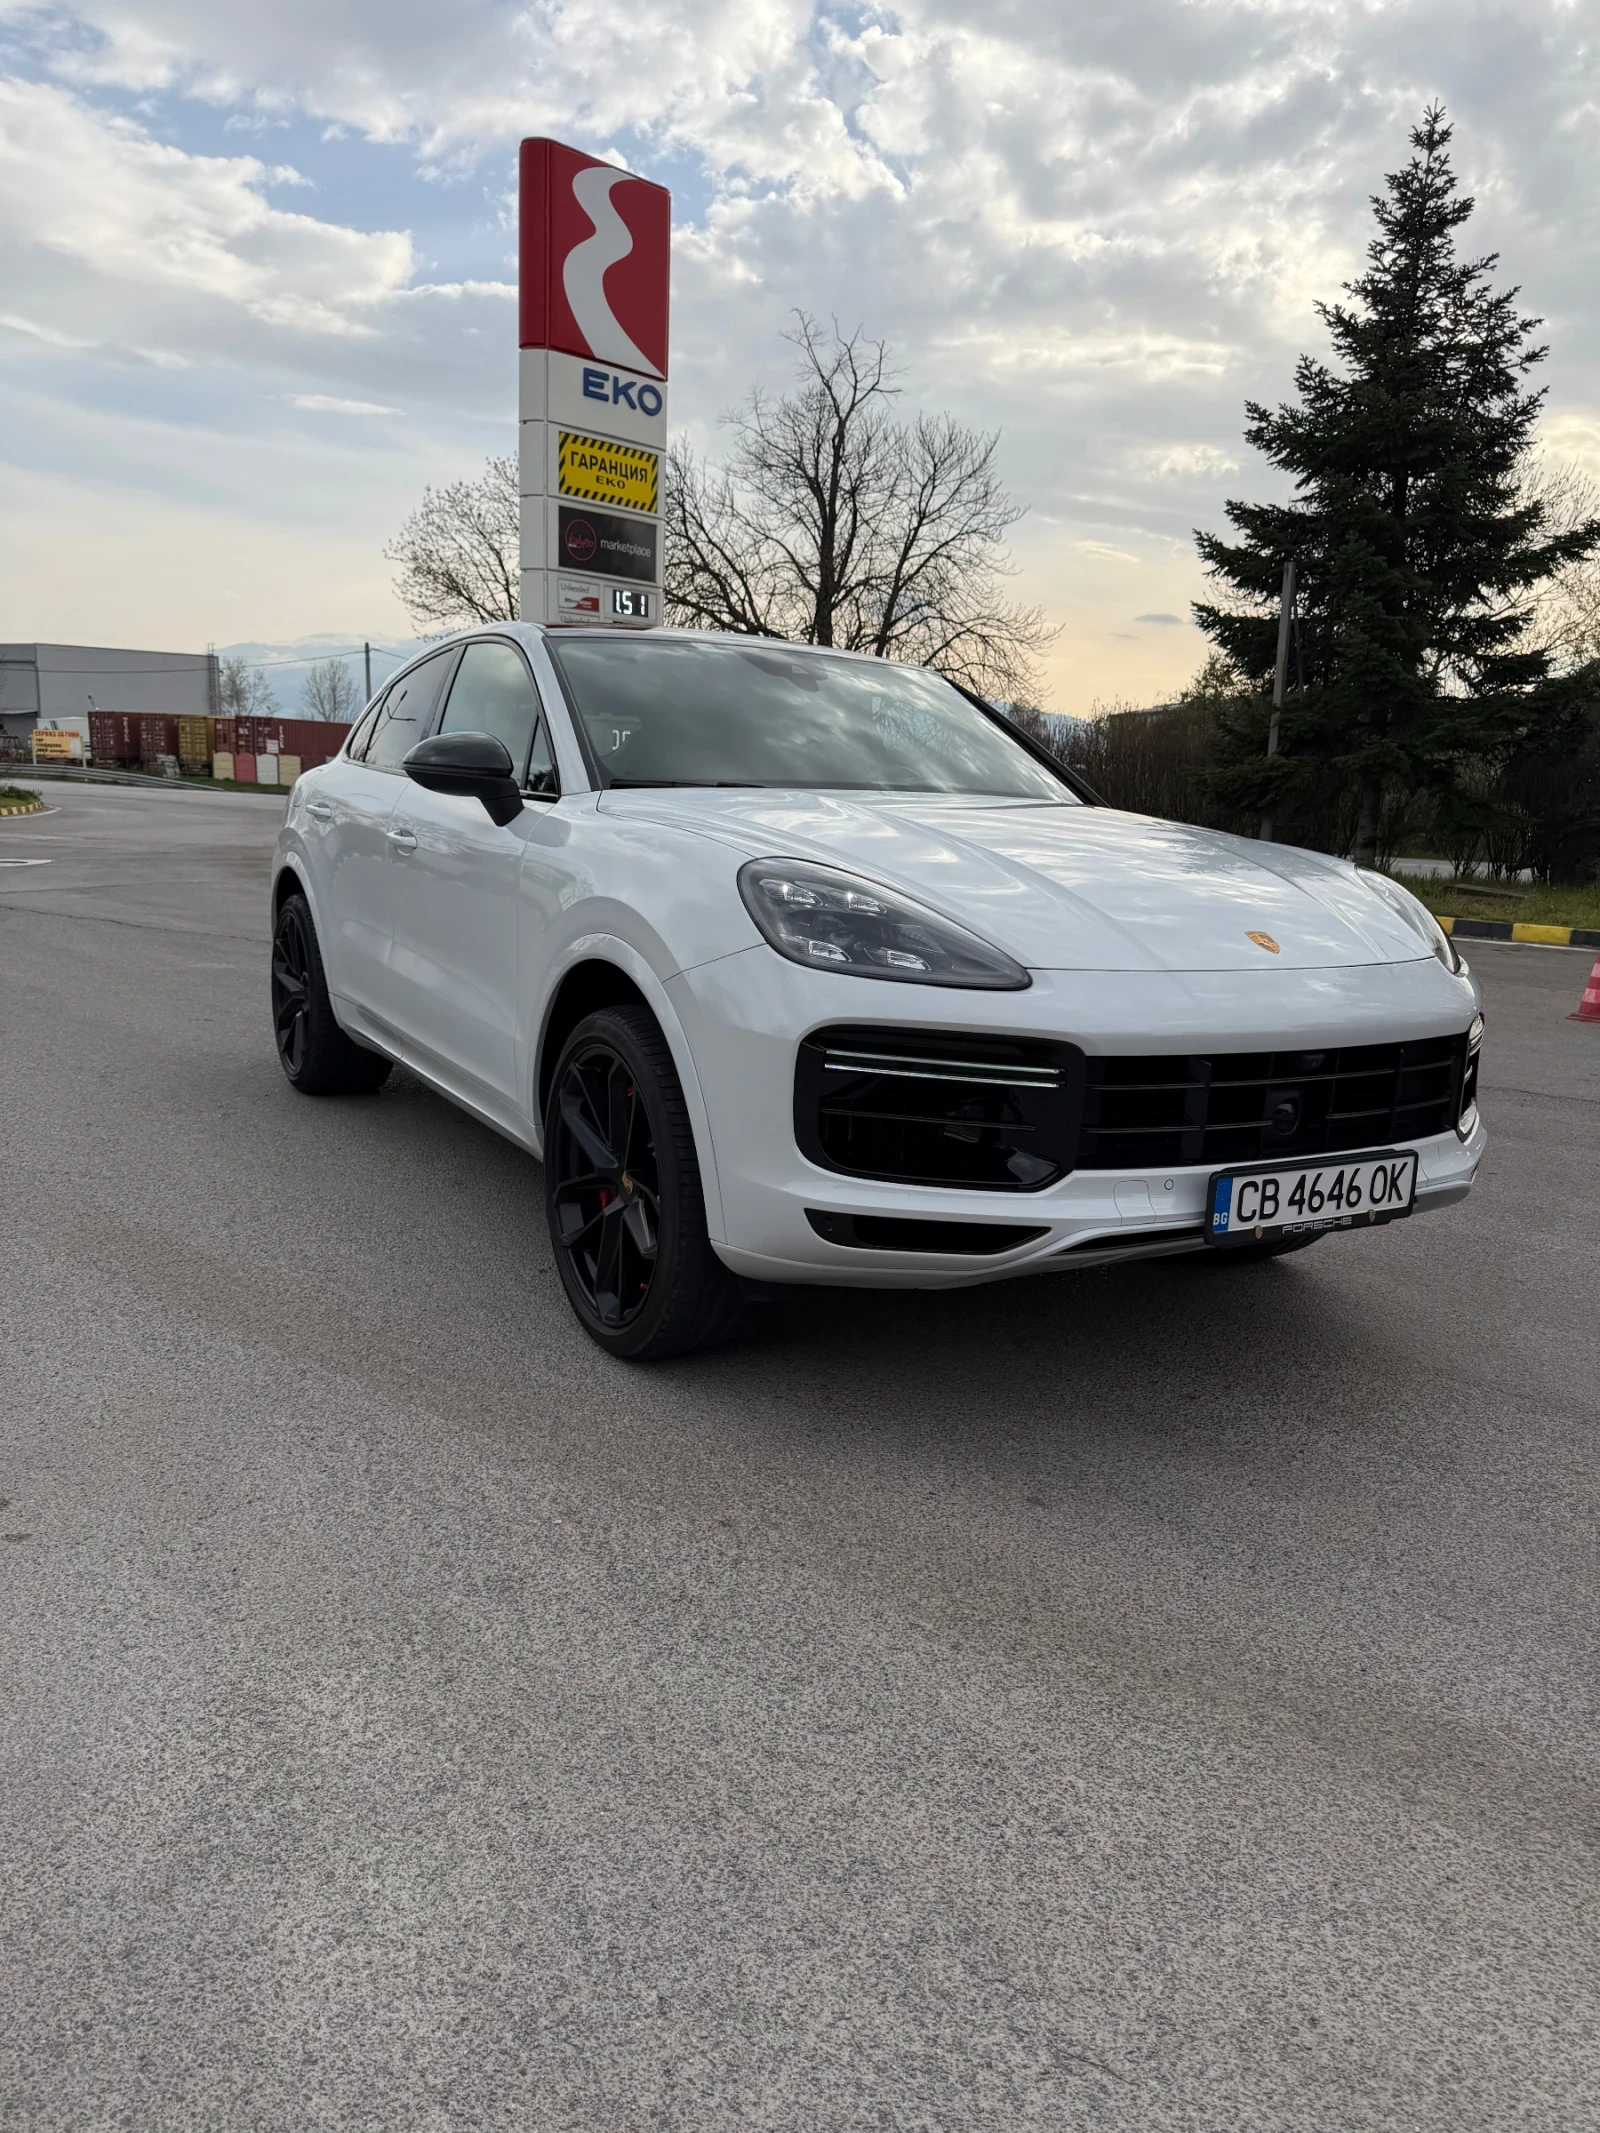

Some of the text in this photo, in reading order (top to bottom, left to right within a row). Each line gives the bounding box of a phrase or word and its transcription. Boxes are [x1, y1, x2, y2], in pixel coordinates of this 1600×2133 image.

[582, 367, 662, 416] EKO
[570, 451, 648, 483] ГАРАНЦИЯ
[600, 539, 651, 557] marketplace
[560, 583, 590, 594] Unleaded
[1237, 1162, 1409, 1223] CB 4646 OK
[1213, 1212, 1228, 1226] BG
[1282, 1216, 1352, 1234] PORSCHE
